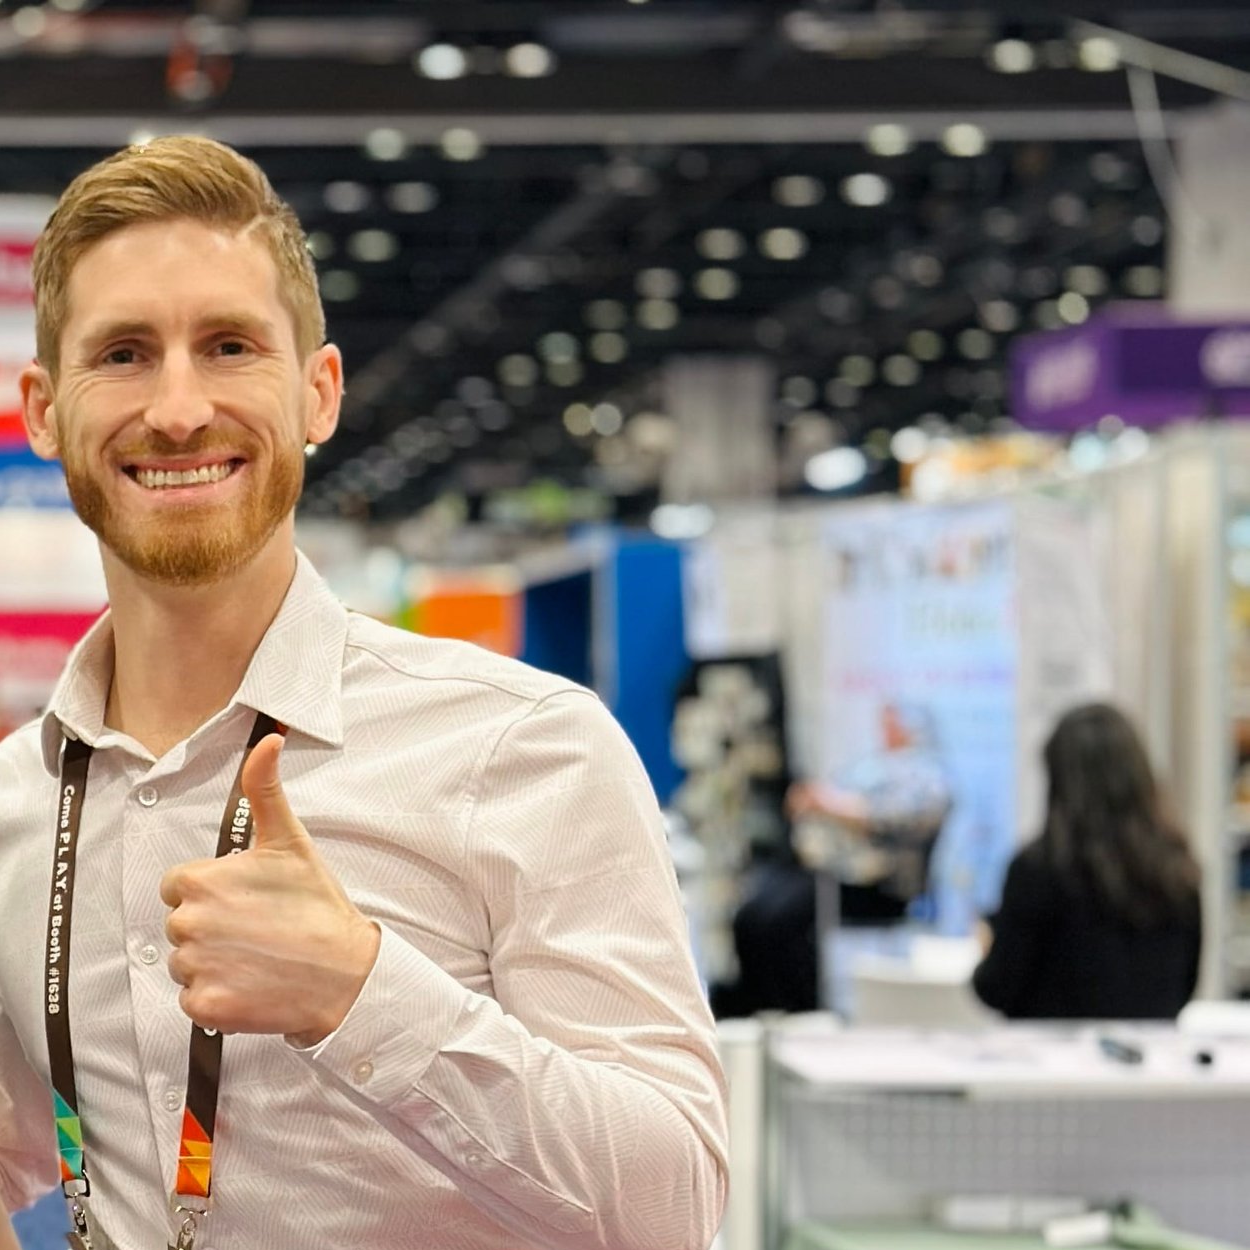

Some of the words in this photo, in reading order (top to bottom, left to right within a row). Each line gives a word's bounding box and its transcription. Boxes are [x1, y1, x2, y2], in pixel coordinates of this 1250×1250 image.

[60, 784, 75, 829] Come
[53, 893, 63, 912] at
[49, 915, 62, 964] Booth
